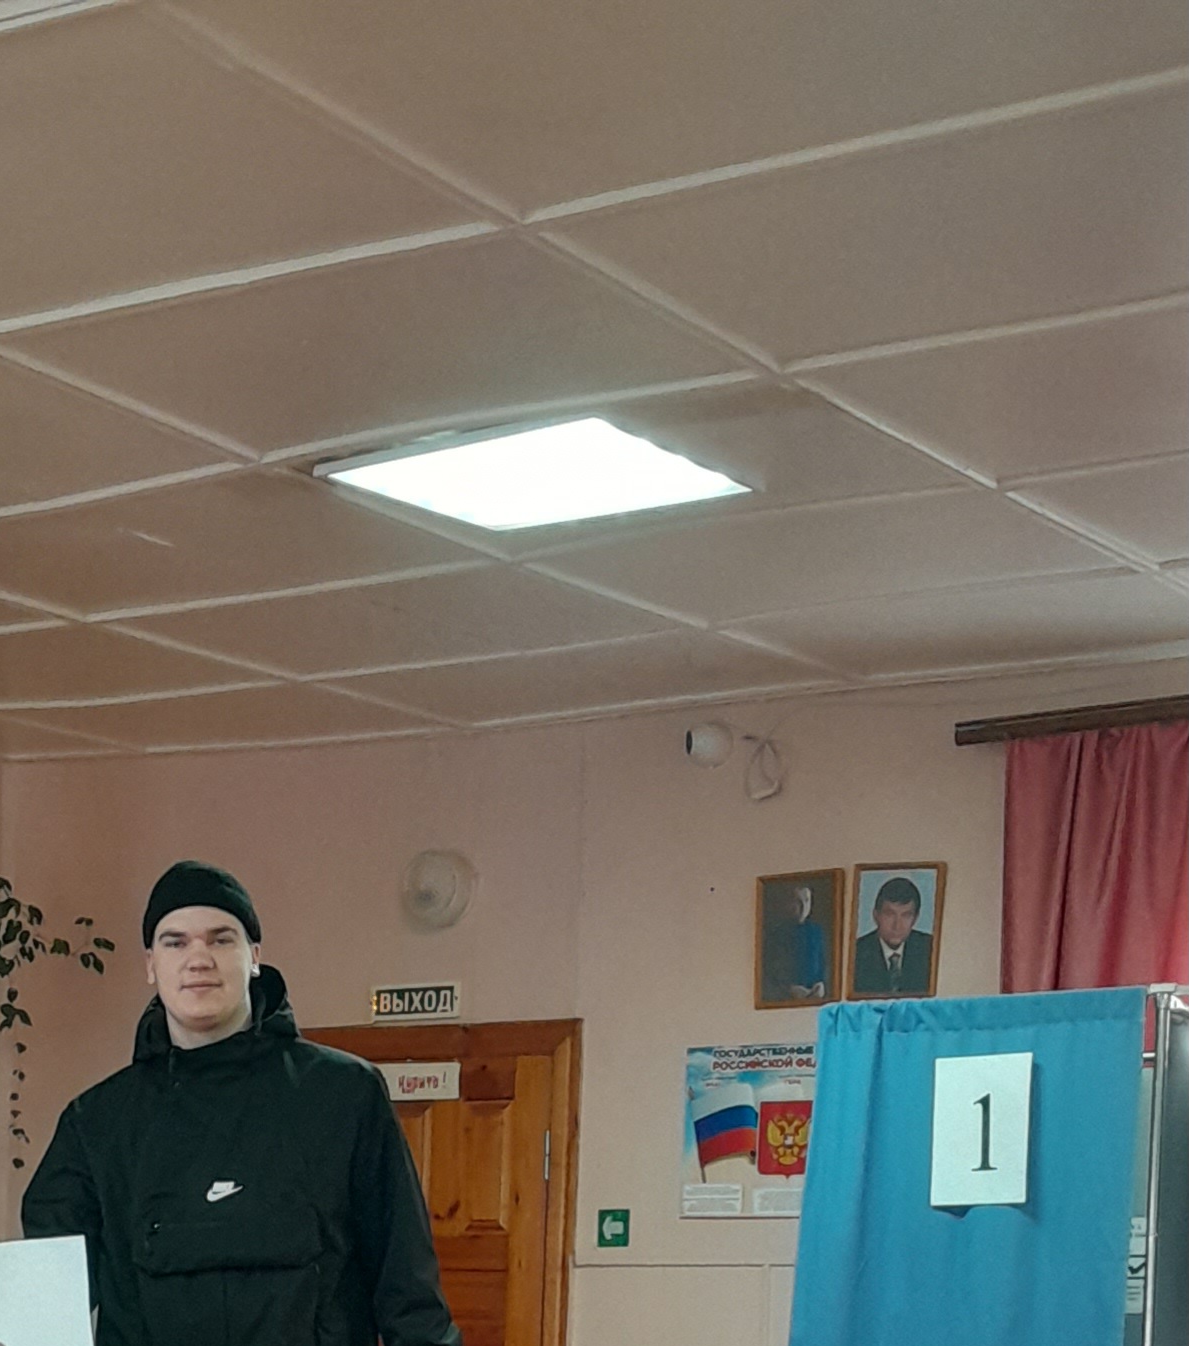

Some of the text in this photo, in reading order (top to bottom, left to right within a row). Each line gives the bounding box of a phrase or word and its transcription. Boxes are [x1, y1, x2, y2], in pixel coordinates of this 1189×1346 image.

[379, 989, 453, 1013] ВЫХОД
[713, 1045, 814, 1059] ГОСУДАРСТВЕННЫЕ
[713, 1056, 793, 1071] РОССИЙСКОЙ
[970, 1092, 998, 1172] 1
